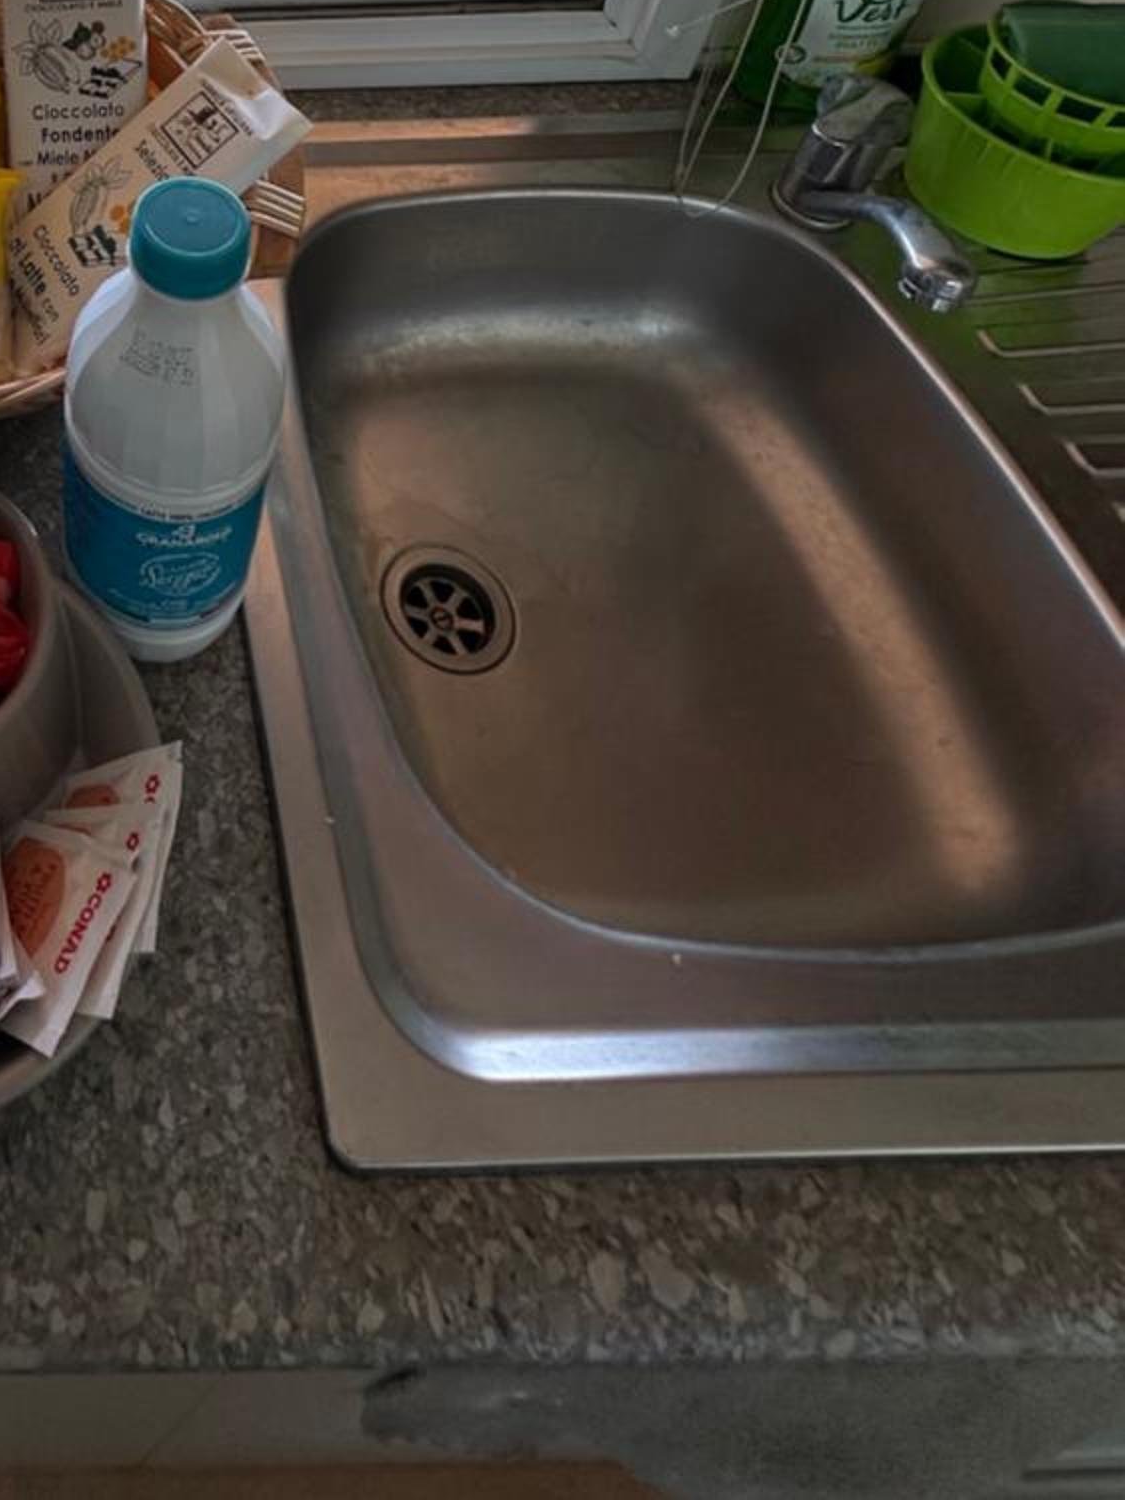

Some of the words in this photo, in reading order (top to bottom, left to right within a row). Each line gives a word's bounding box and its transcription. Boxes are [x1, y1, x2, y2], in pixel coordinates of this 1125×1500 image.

[32, 103, 124, 120] Cioccolato
[37, 150, 79, 166] Miele
[21, 254, 47, 295] Latte
[32, 225, 79, 296] Cioccolato
[53, 894, 103, 975] CONAD
